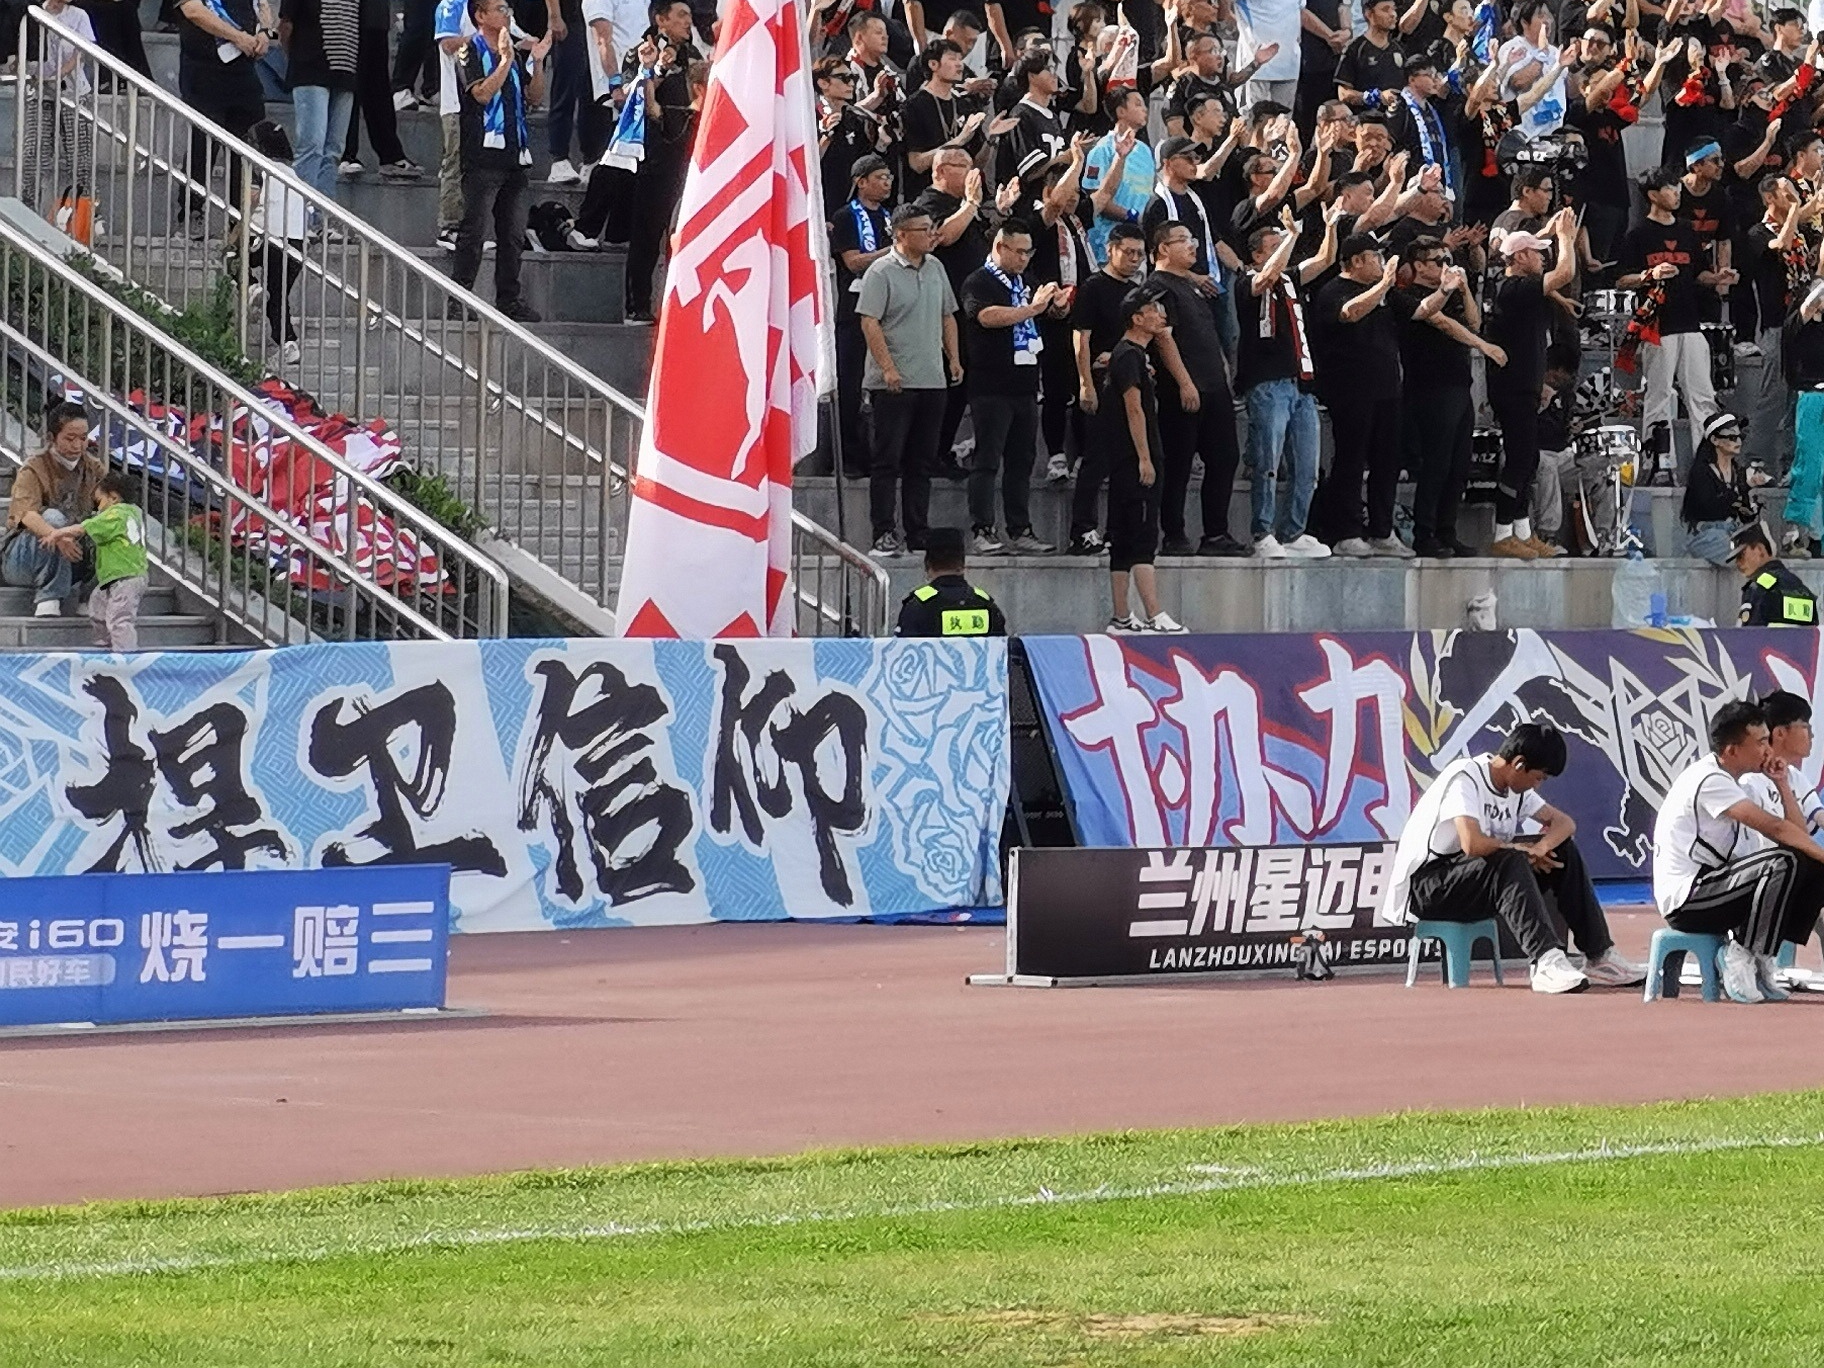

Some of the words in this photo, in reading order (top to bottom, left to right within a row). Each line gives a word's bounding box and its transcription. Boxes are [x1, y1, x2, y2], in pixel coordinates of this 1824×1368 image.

[65, 643, 875, 907] 捍卫信仰
[139, 901, 435, 984] 烧一赔三
[1149, 941, 1342, 970] LANZHOUXINGAI
[1350, 937, 1442, 961] ESPOTS
[0, 958, 91, 988] 民好车
